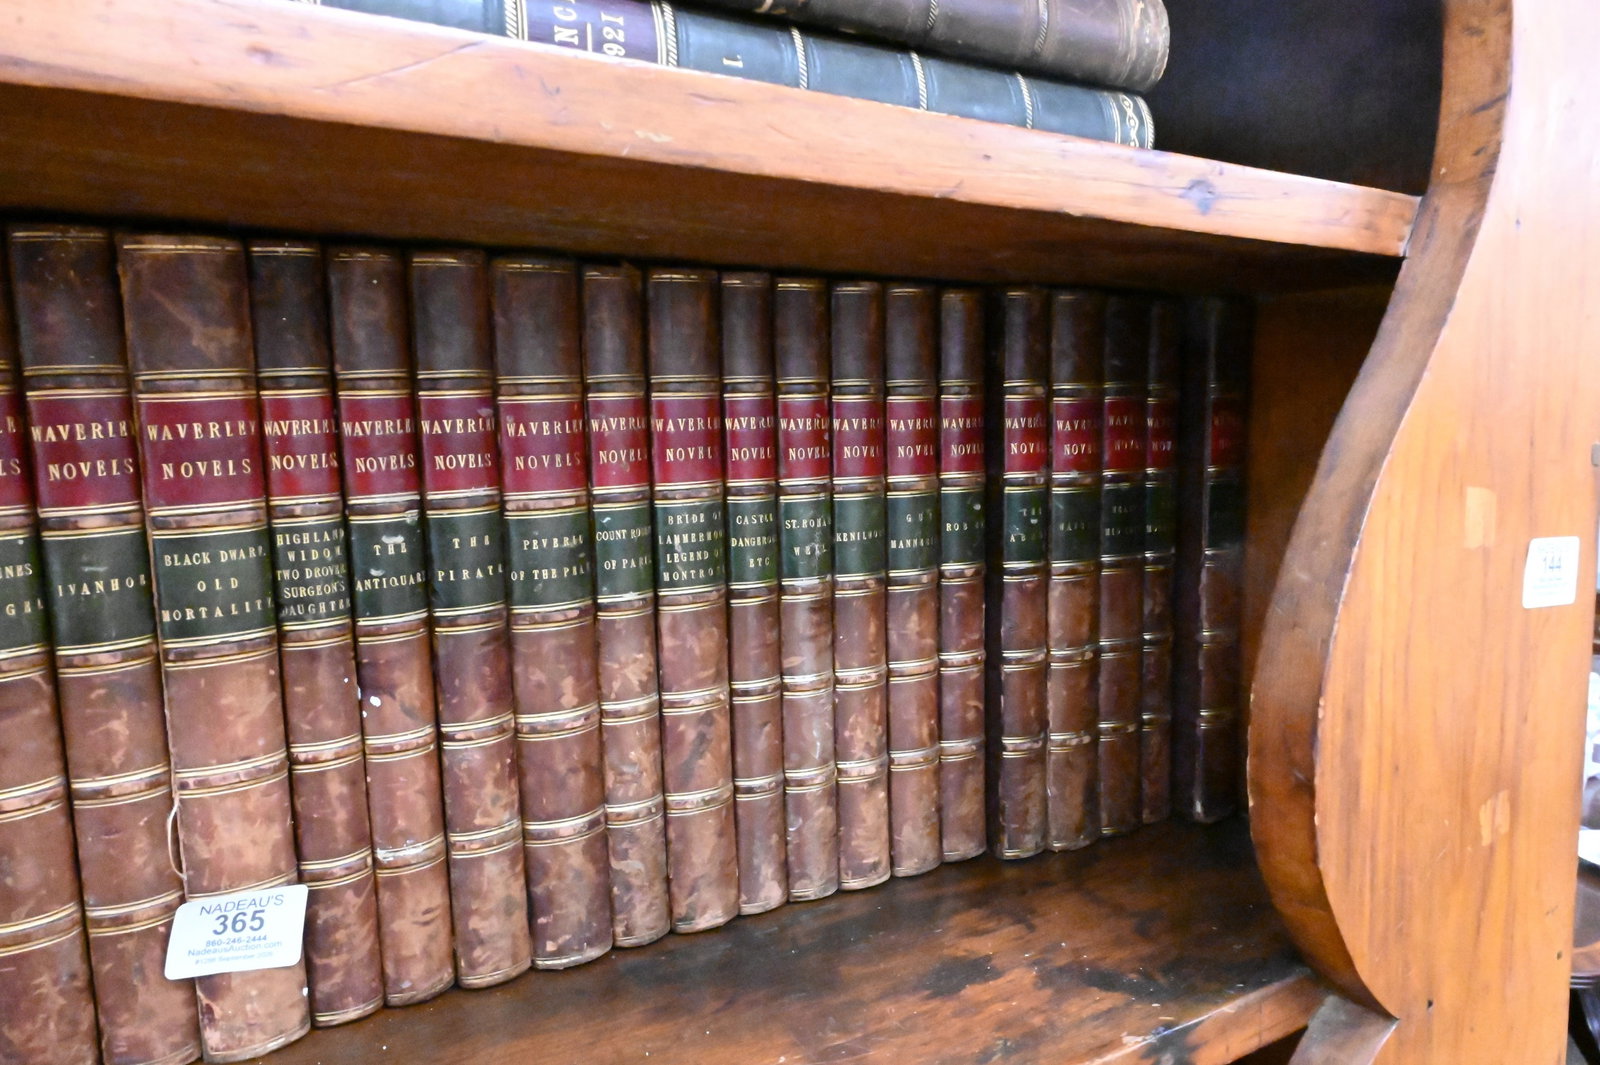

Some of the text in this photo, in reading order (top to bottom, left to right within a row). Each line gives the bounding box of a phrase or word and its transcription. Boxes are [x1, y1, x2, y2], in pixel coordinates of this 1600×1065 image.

[147, 420, 256, 441] WAVERLEY
[49, 458, 134, 481] NOVELS
[161, 458, 251, 480] NOVELS
[271, 452, 338, 471] NOVELS
[355, 453, 415, 473] NOVELS
[434, 453, 492, 471] NOVELS
[515, 452, 581, 471] NOVELS
[667, 513, 706, 526] BRIDE
[276, 528, 345, 546] HIGHLAND
[452, 535, 491, 549] THE
[596, 529, 627, 542] COUNT
[374, 541, 408, 556] THE
[163, 551, 211, 567] BLACK
[604, 559, 617, 570] OF
[666, 551, 710, 564] LEGEND
[749, 556, 771, 569] ETC
[276, 568, 300, 581] TWO
[510, 570, 526, 581] OF
[533, 567, 558, 580] THE
[197, 576, 239, 593] OLD
[199, 894, 285, 916] NADEAU'S
[212, 909, 266, 936] 365
[187, 940, 283, 957] NadeausAuction.com
[205, 934, 268, 948] 860-246-2444
